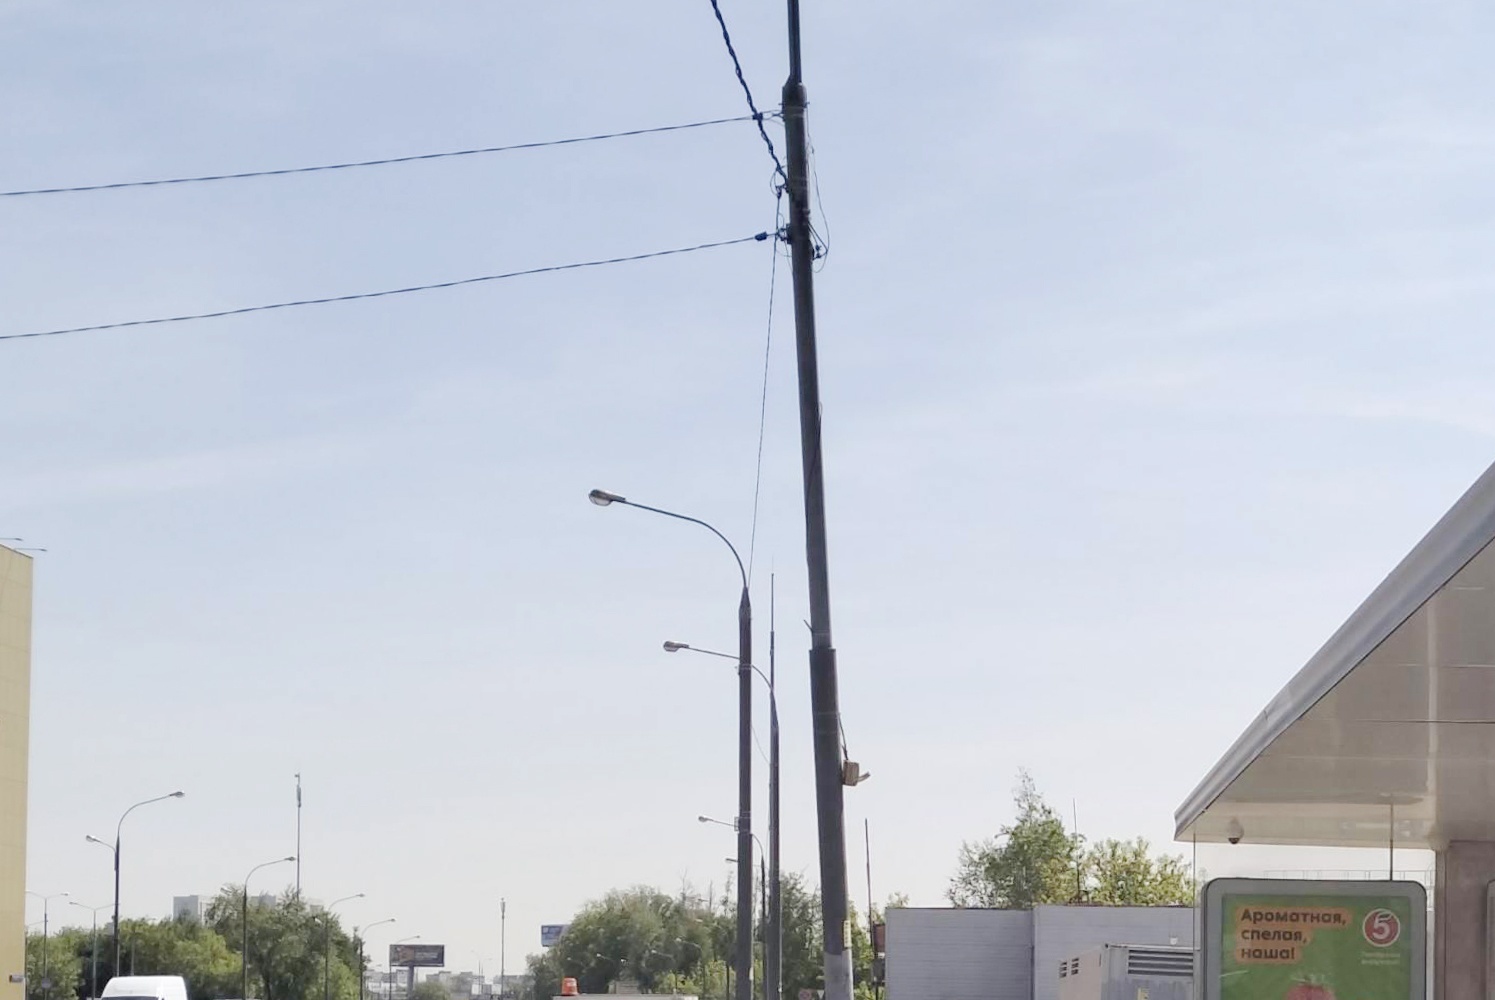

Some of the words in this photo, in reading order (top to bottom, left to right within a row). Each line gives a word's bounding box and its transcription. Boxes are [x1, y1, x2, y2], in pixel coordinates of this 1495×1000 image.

[1241, 909, 1347, 926] Ароматная,
[1241, 928, 1307, 944] спелая,
[1241, 947, 1295, 960] наша!
